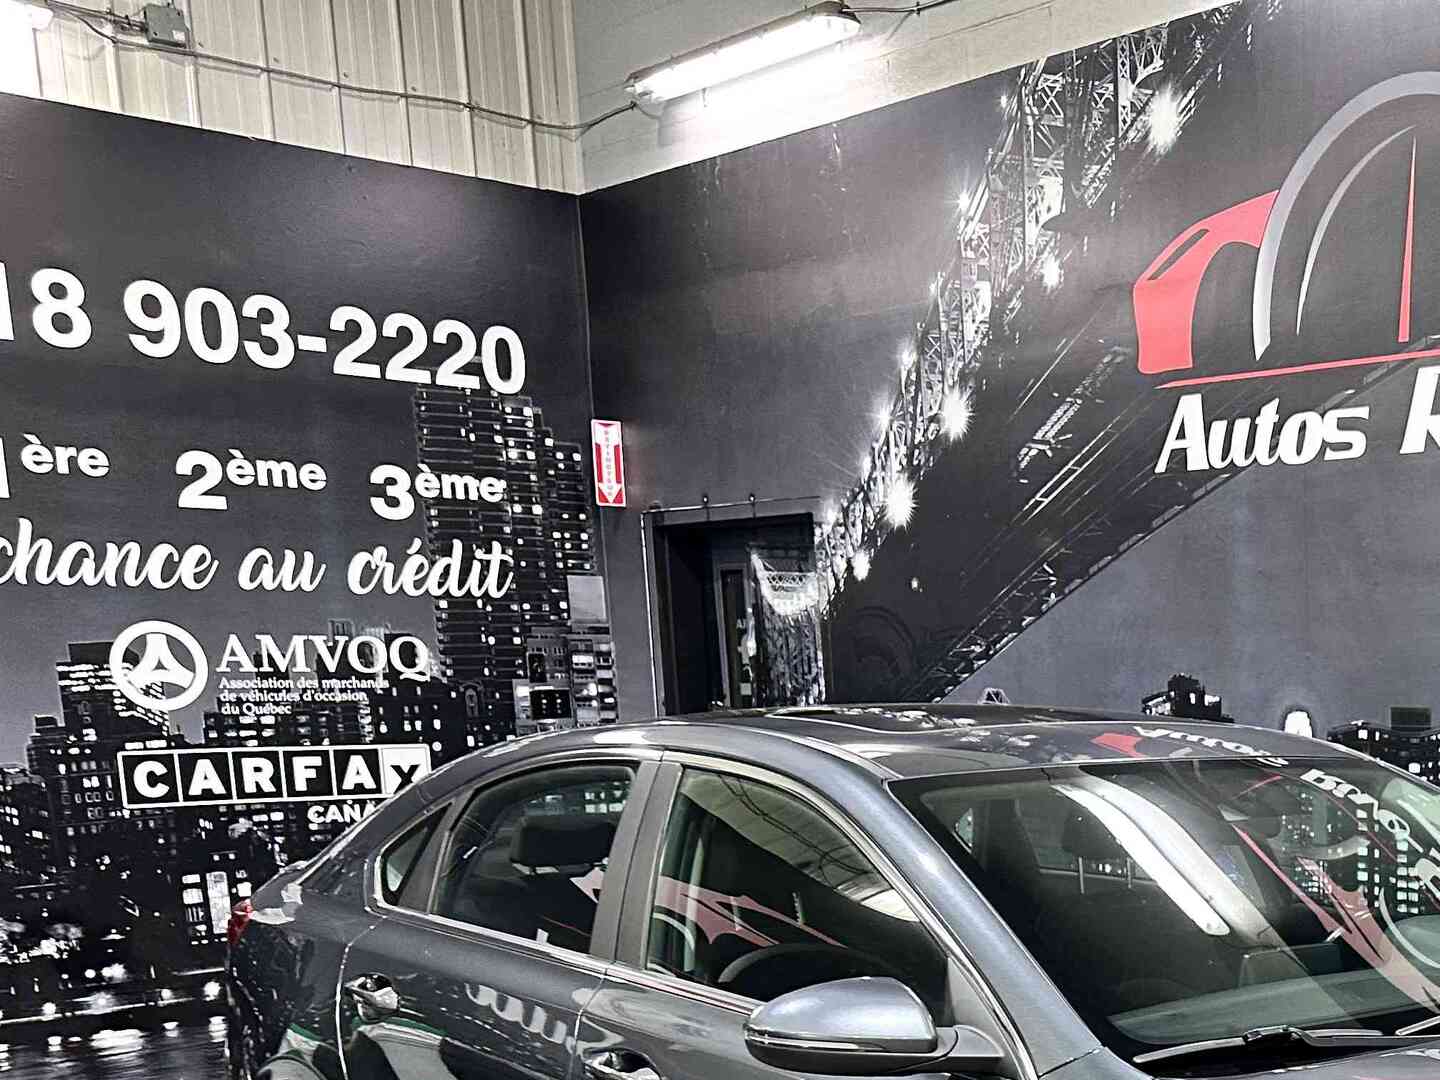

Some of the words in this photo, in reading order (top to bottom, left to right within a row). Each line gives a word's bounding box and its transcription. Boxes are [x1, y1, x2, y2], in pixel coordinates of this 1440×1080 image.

[0, 261, 93, 349] 8
[122, 278, 527, 395] 903-2220
[1154, 393, 1371, 474] Autos
[0, 433, 111, 499] ère
[176, 449, 327, 511] 2ème
[369, 464, 506, 521] 3ème
[237, 550, 326, 596] au
[347, 538, 516, 599] crédit
[215, 633, 431, 682] AMVOQ
[219, 677, 294, 689] Association
[297, 677, 319, 689] des
[321, 677, 390, 689] marchands
[219, 690, 238, 702] de
[239, 690, 300, 702] véhicules
[303, 690, 369, 702] d'occasion
[221, 703, 240, 715] du
[242, 702, 292, 717] Québec
